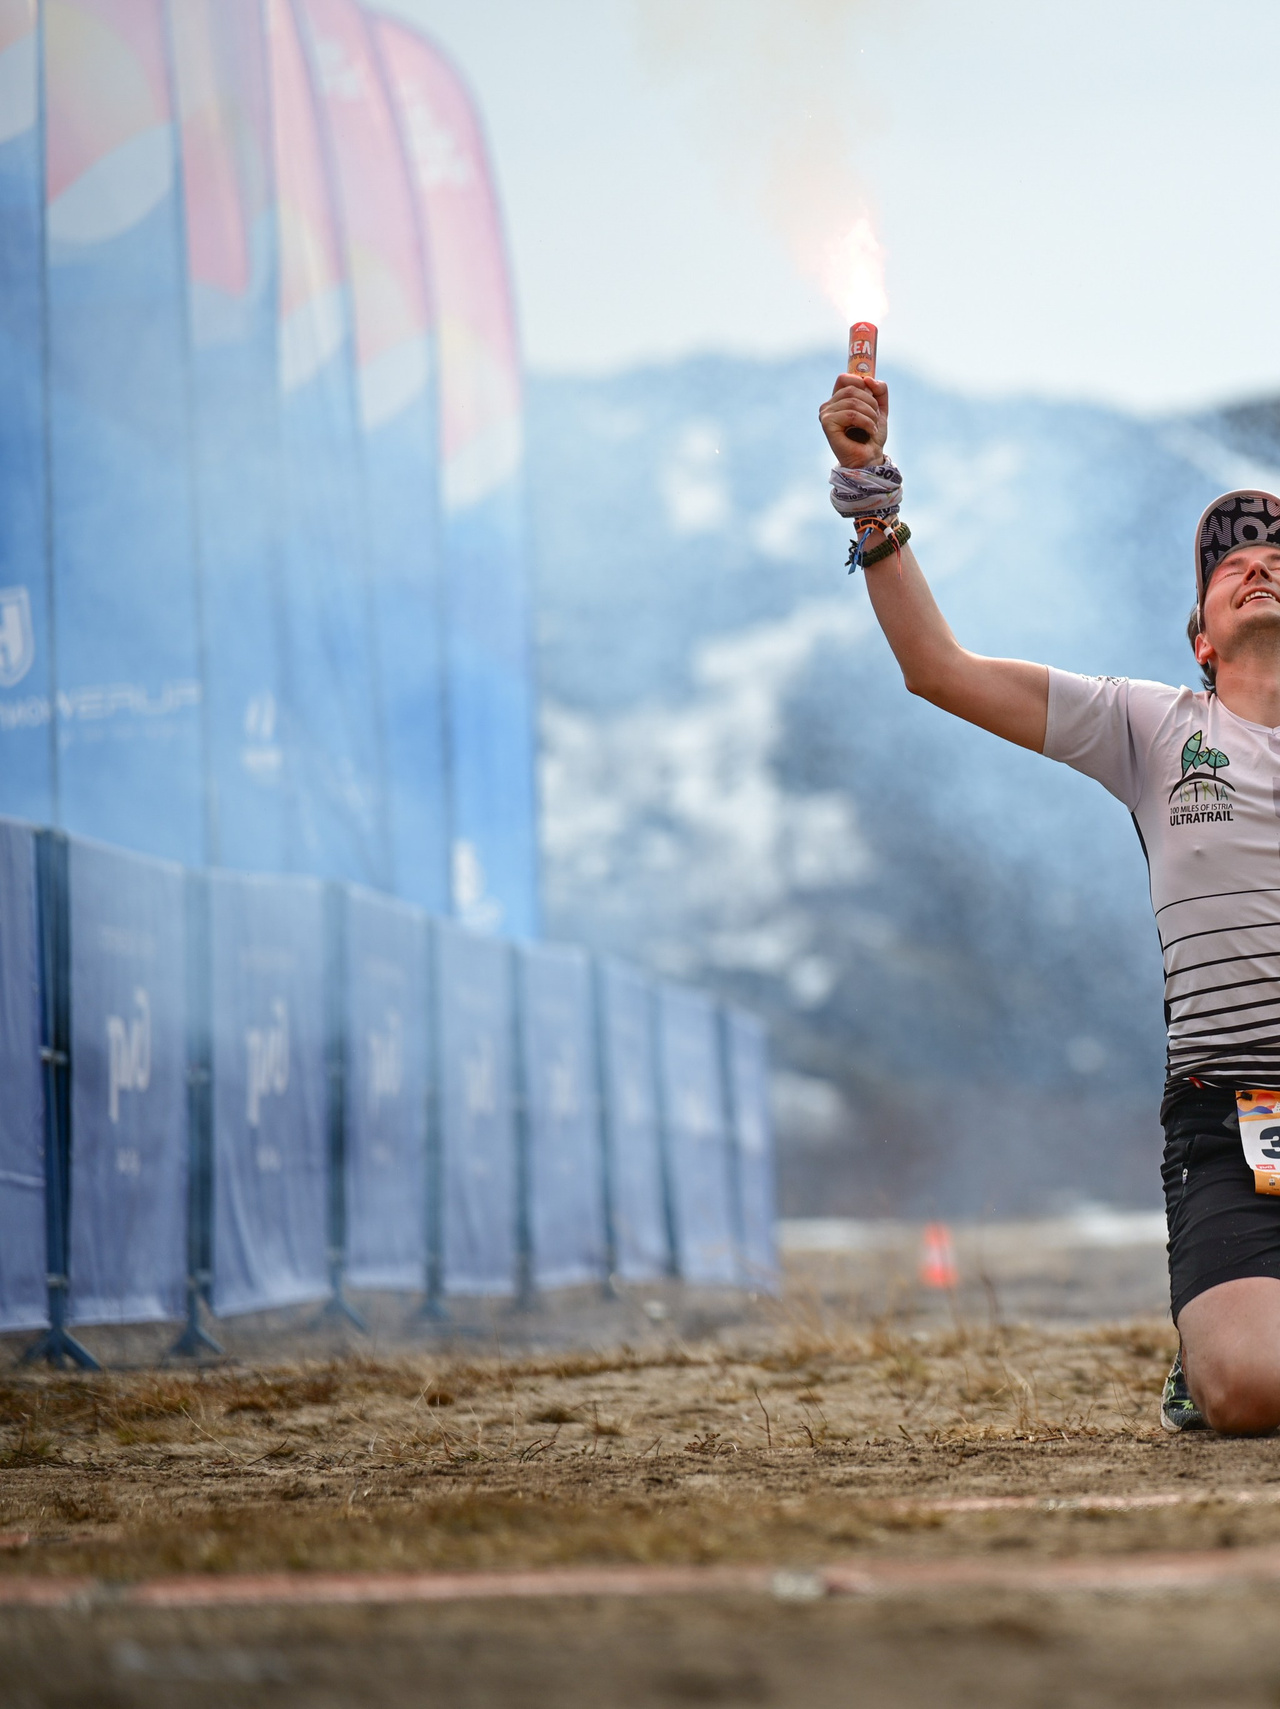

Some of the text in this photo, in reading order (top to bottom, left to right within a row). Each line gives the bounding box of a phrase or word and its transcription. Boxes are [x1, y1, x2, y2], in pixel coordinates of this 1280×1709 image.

[876, 466, 894, 480] 30
[1180, 781, 1229, 803] ISTRIA
[1170, 803, 1234, 815] 100 MILES OF ISTRIA
[1170, 810, 1234, 827] ULTRATRAIL
